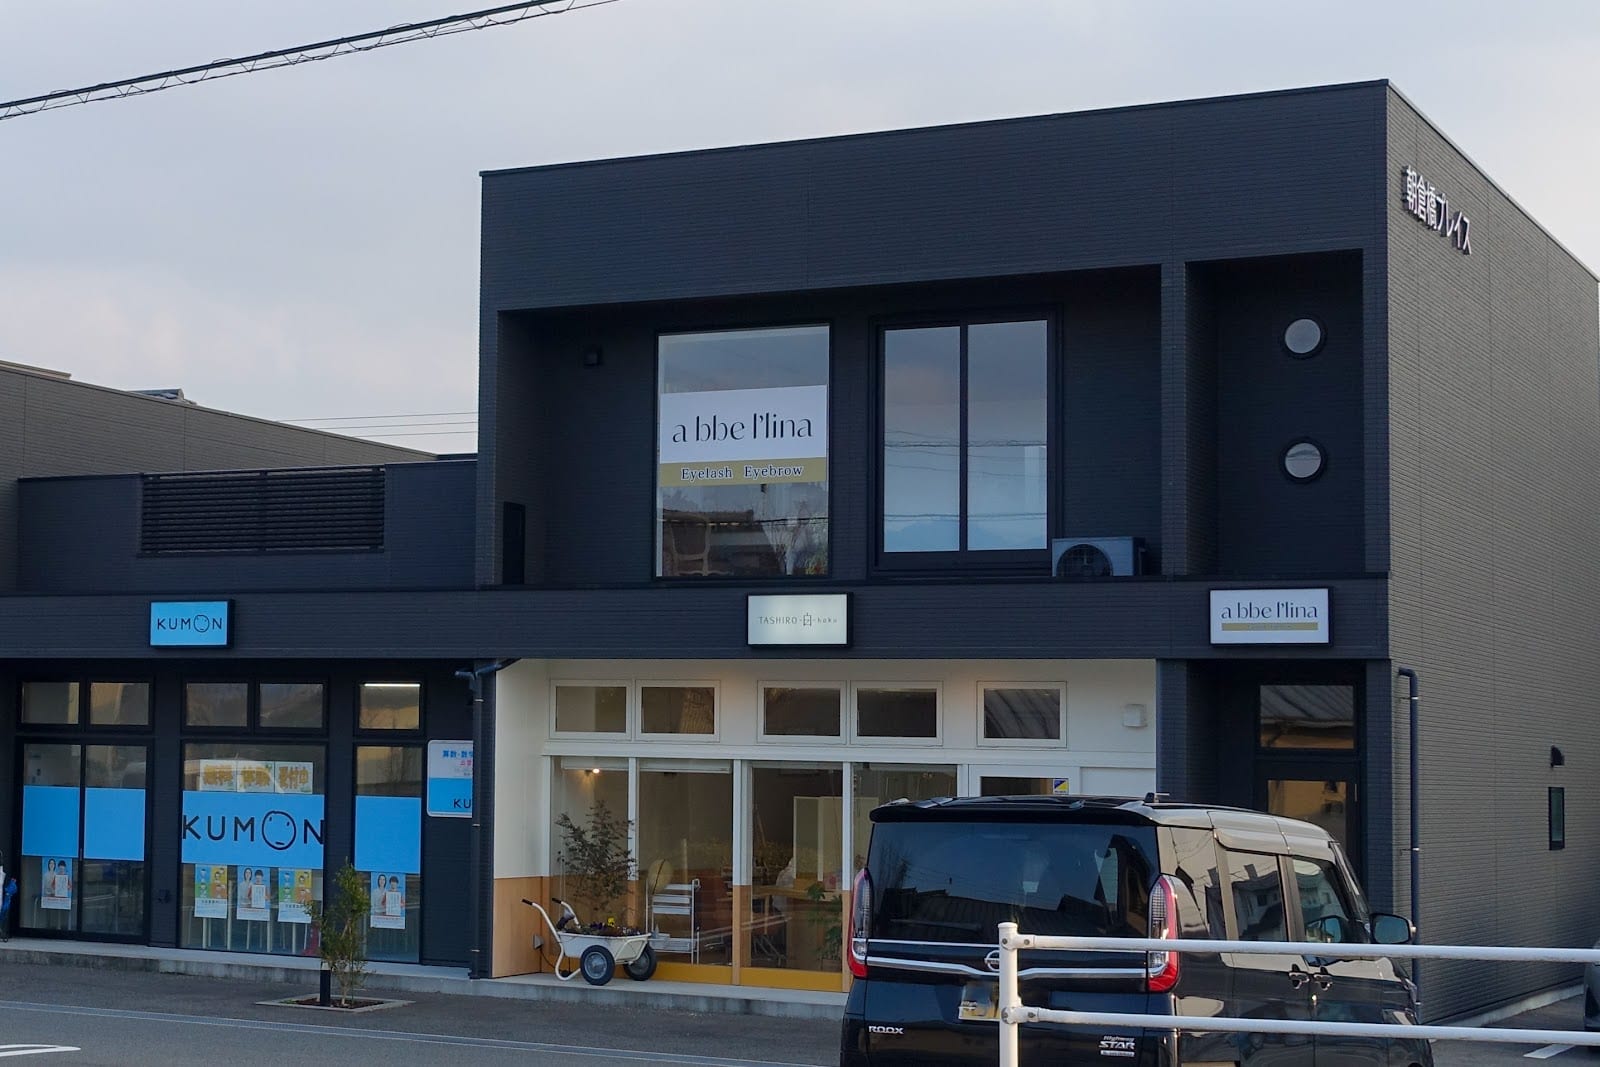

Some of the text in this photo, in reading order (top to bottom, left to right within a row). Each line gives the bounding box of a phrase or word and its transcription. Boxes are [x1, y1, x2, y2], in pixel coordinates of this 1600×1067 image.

[681, 464, 804, 483] Eyelash Eyebrow
[156, 614, 223, 633] KUMON
[182, 810, 325, 851] KUMON
[868, 1025, 905, 1035] ROOX
[1098, 1041, 1136, 1050] STAR
